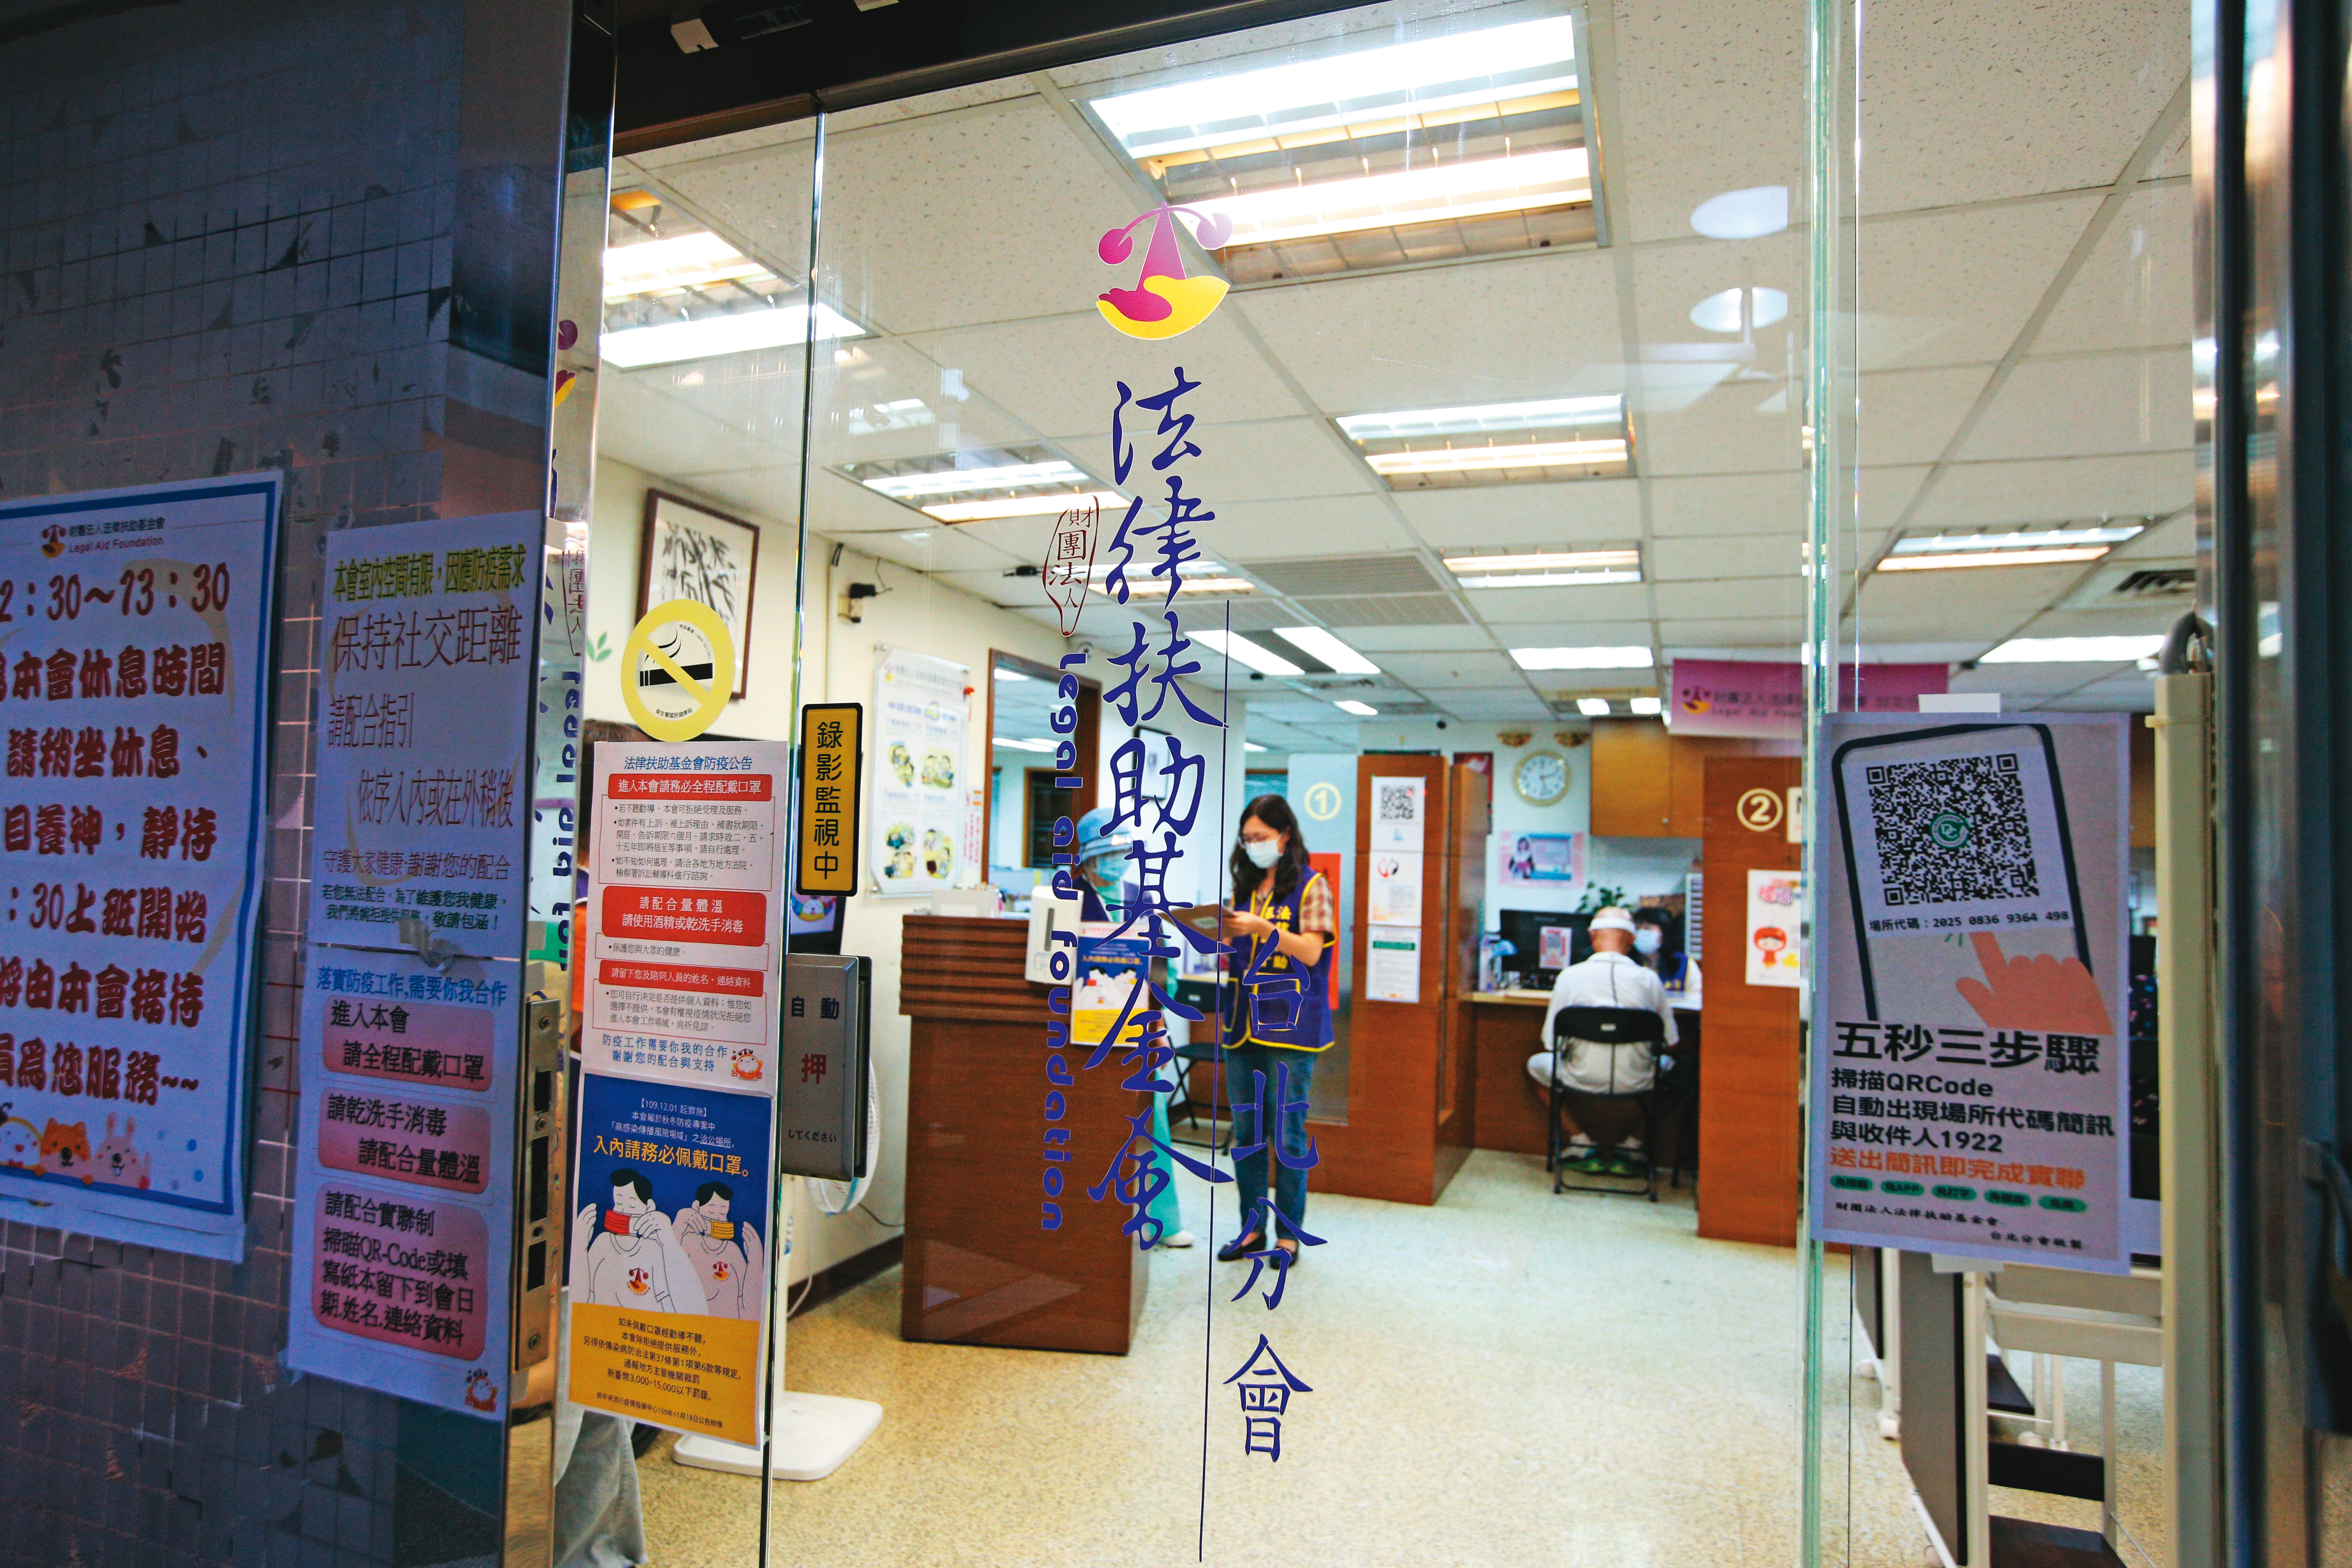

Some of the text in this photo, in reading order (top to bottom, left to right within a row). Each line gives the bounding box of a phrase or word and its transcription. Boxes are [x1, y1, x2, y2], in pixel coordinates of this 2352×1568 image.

[70, 536, 164, 555] Legal Aid Foundation
[1049, 506, 1095, 608] 財團法人
[333, 543, 526, 602] 本會室內空間有限，因應防疫需求
[333, 604, 523, 672] 保持社交距離
[0, 642, 225, 702] 本會休息時間
[329, 692, 414, 748] 請配合指引
[624, 756, 753, 771] 法律扶助基金會防疫公告
[618, 780, 761, 794] 進入本會請務必全程配戴口罩
[814, 722, 843, 880] 錄影監視中
[619, 803, 747, 815] 若不聽勸導，本會可拒絕受理及服務。
[1083, 367, 1237, 1249] 法律扶助基金會
[616, 843, 745, 855] 十五年即將屆至等事項，請自行處理。
[617, 830, 763, 843] 開庭、告訴期限六個月、請求時效二、五、
[616, 856, 753, 871] 如不知如何處理，請洽各地方地方法院、
[616, 868, 713, 881] 檢察署訴訟輔導科進行諮詢。
[640, 896, 723, 913] 請配合量體溫
[1969, 914, 1999, 925] 0836
[2007, 912, 2038, 924] 9364
[2046, 911, 2069, 921] 498
[622, 913, 743, 933] 請使用酒精或乾洗手消毒
[1041, 653, 1086, 1230] legal aid foundation
[611, 968, 751, 988] 請留下您及陪同人員的姓名、連絡資料
[610, 990, 751, 1010] 您可自行決定是否提供個人資料；惟您如
[610, 1002, 751, 1023] 選擇不提供，本會有權視疫情狀況拒絕您
[331, 999, 409, 1033] 進入本會
[610, 1013, 714, 1032] 進入本會工作場域，尚祈見諒。
[603, 1034, 728, 1058] 防疫工作需要你我的合作
[612, 1050, 714, 1072] 謝謝您的配合與支持
[1833, 1021, 2100, 1075] 五秒三步驟
[343, 1040, 484, 1083] 請全程配戴口罩
[802, 1053, 827, 1084] 押
[1832, 1067, 1993, 1097] 掃描QRCode
[327, 1093, 447, 1136] 請乾洗手消毒
[632, 1111, 715, 1131] 本會屬於秋冬防疫專案中
[1833, 1096, 2116, 1137] 自動出現場所代碼簡訊
[789, 1129, 837, 1142] してください
[1831, 1120, 2002, 1153] 與收件人1922
[359, 1137, 480, 1183] 請配合量體溫
[593, 1135, 748, 1177] 入內請務必佩戴口罩。
[1830, 1147, 2085, 1190] 送出簡訊即完成實聯
[1223, 929, 1328, 1462] 台北分會
[325, 1190, 435, 1236] 請配合實聯制
[1835, 1200, 1999, 1226] 財團法人法律扶助基金會
[323, 1258, 473, 1314] 寫紙本留下到會日
[622, 1332, 701, 1357] 本會除拒絕提供服務外，
[624, 1359, 699, 1384] 通報地方主管機關裁罰
[597, 1391, 723, 1428] 依中央流行疫情指揮中心109年11月18日公告辦理
